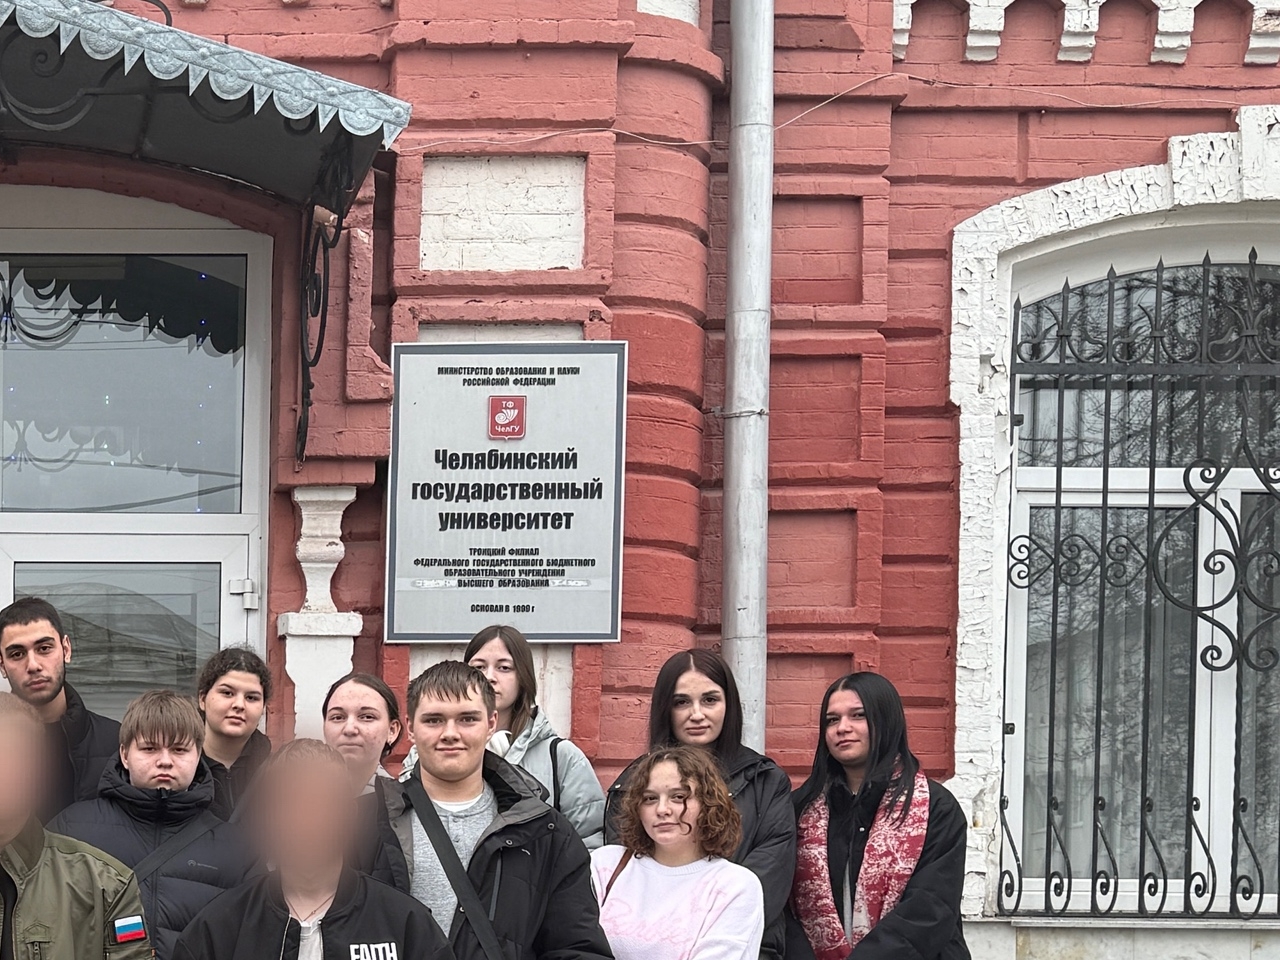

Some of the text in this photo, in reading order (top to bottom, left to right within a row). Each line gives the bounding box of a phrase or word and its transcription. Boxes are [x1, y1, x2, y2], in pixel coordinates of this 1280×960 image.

[437, 367, 493, 375] МИНИСТЕРСТВО
[495, 367, 547, 376] ОБРАЗОВАНИЯ
[557, 367, 580, 376] НАУКИ
[462, 377, 556, 387] РОССИЙСКОЙ ФЕДЕРАЦИИ
[501, 400, 515, 408] ТФ
[494, 424, 521, 433] ЧелГУ
[434, 447, 578, 471] Челябинский
[411, 477, 603, 503] государственный
[438, 511, 575, 532] университет
[469, 546, 540, 556] ТРОИЦКИЙ ФИЛИАЛ
[413, 558, 596, 568] ФЕДЕРАЛЬНОГО ГОСУДАРСТВЕННОГО БЮДЖЕТНОГО
[443, 568, 566, 578] ОБРАЗОВАТЕЛЬНОГО УЧРЕЖДЕНИЯ
[457, 578, 550, 588] ВЫСШЕГО ОБРАЗОВАНИЯ
[470, 604, 504, 613] ОСНОВАН
